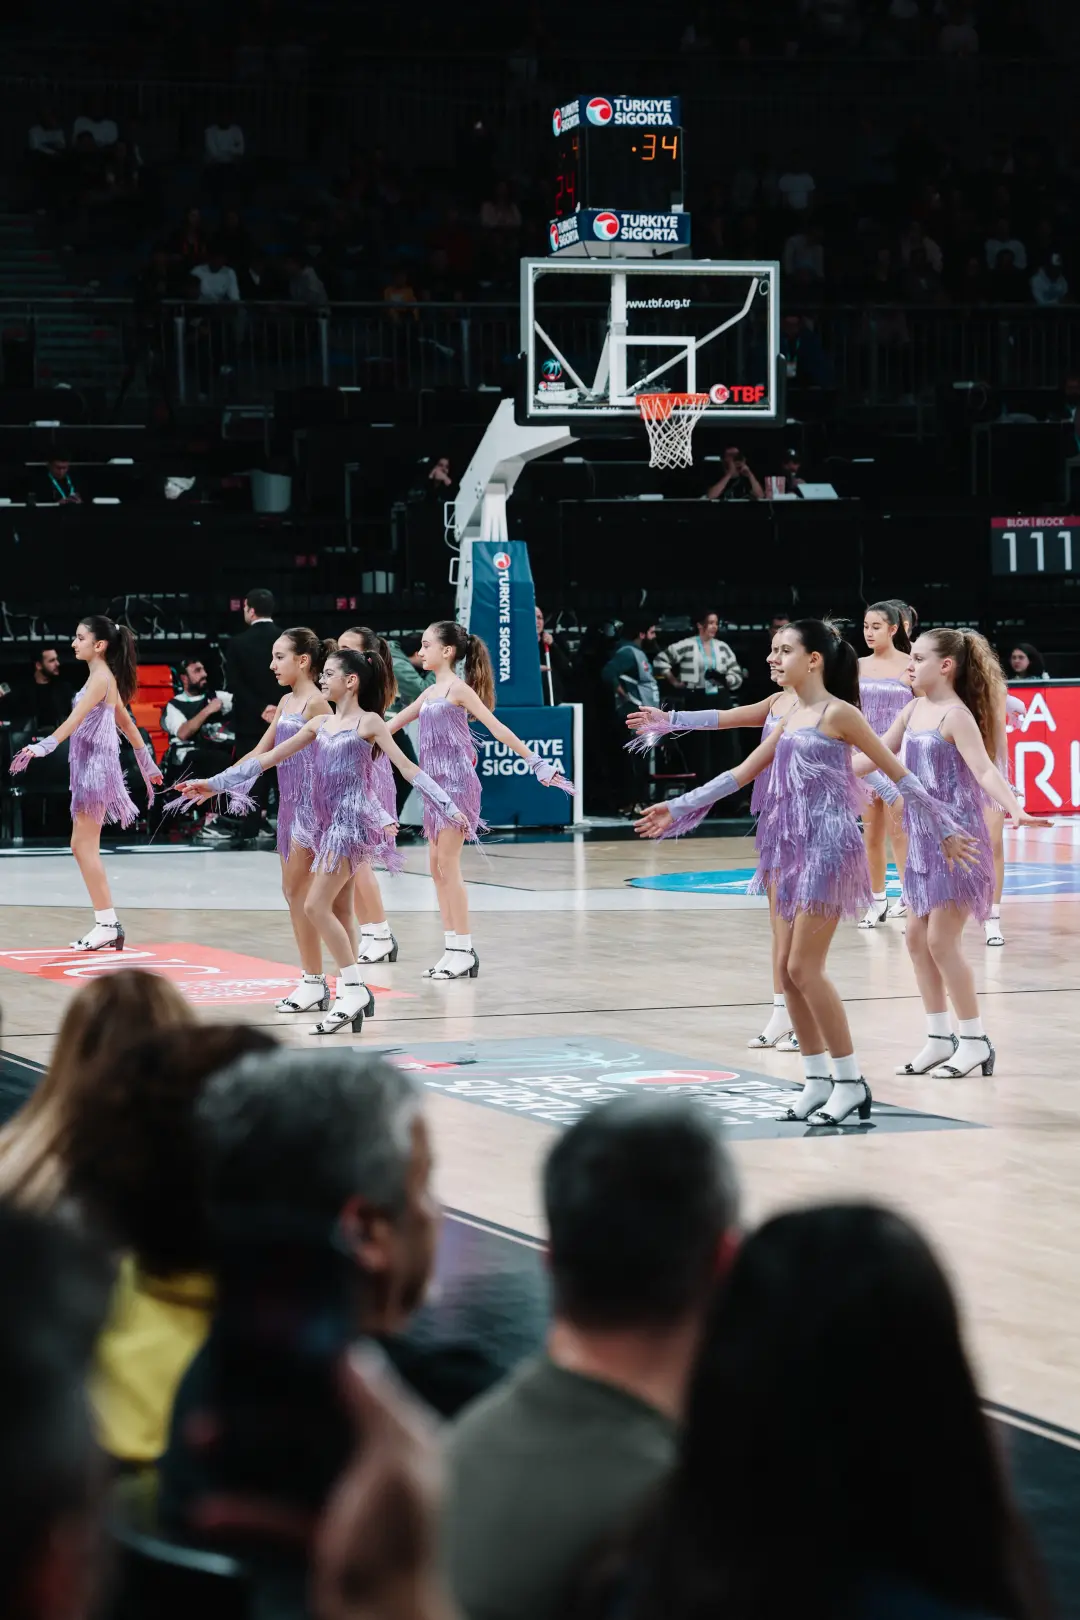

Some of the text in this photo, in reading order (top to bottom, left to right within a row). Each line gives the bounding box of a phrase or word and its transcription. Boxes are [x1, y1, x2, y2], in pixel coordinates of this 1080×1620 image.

[730, 385, 765, 403] TBF
[1007, 517, 1065, 527] BLOK BLOCK
[1002, 530, 1073, 572] 111
